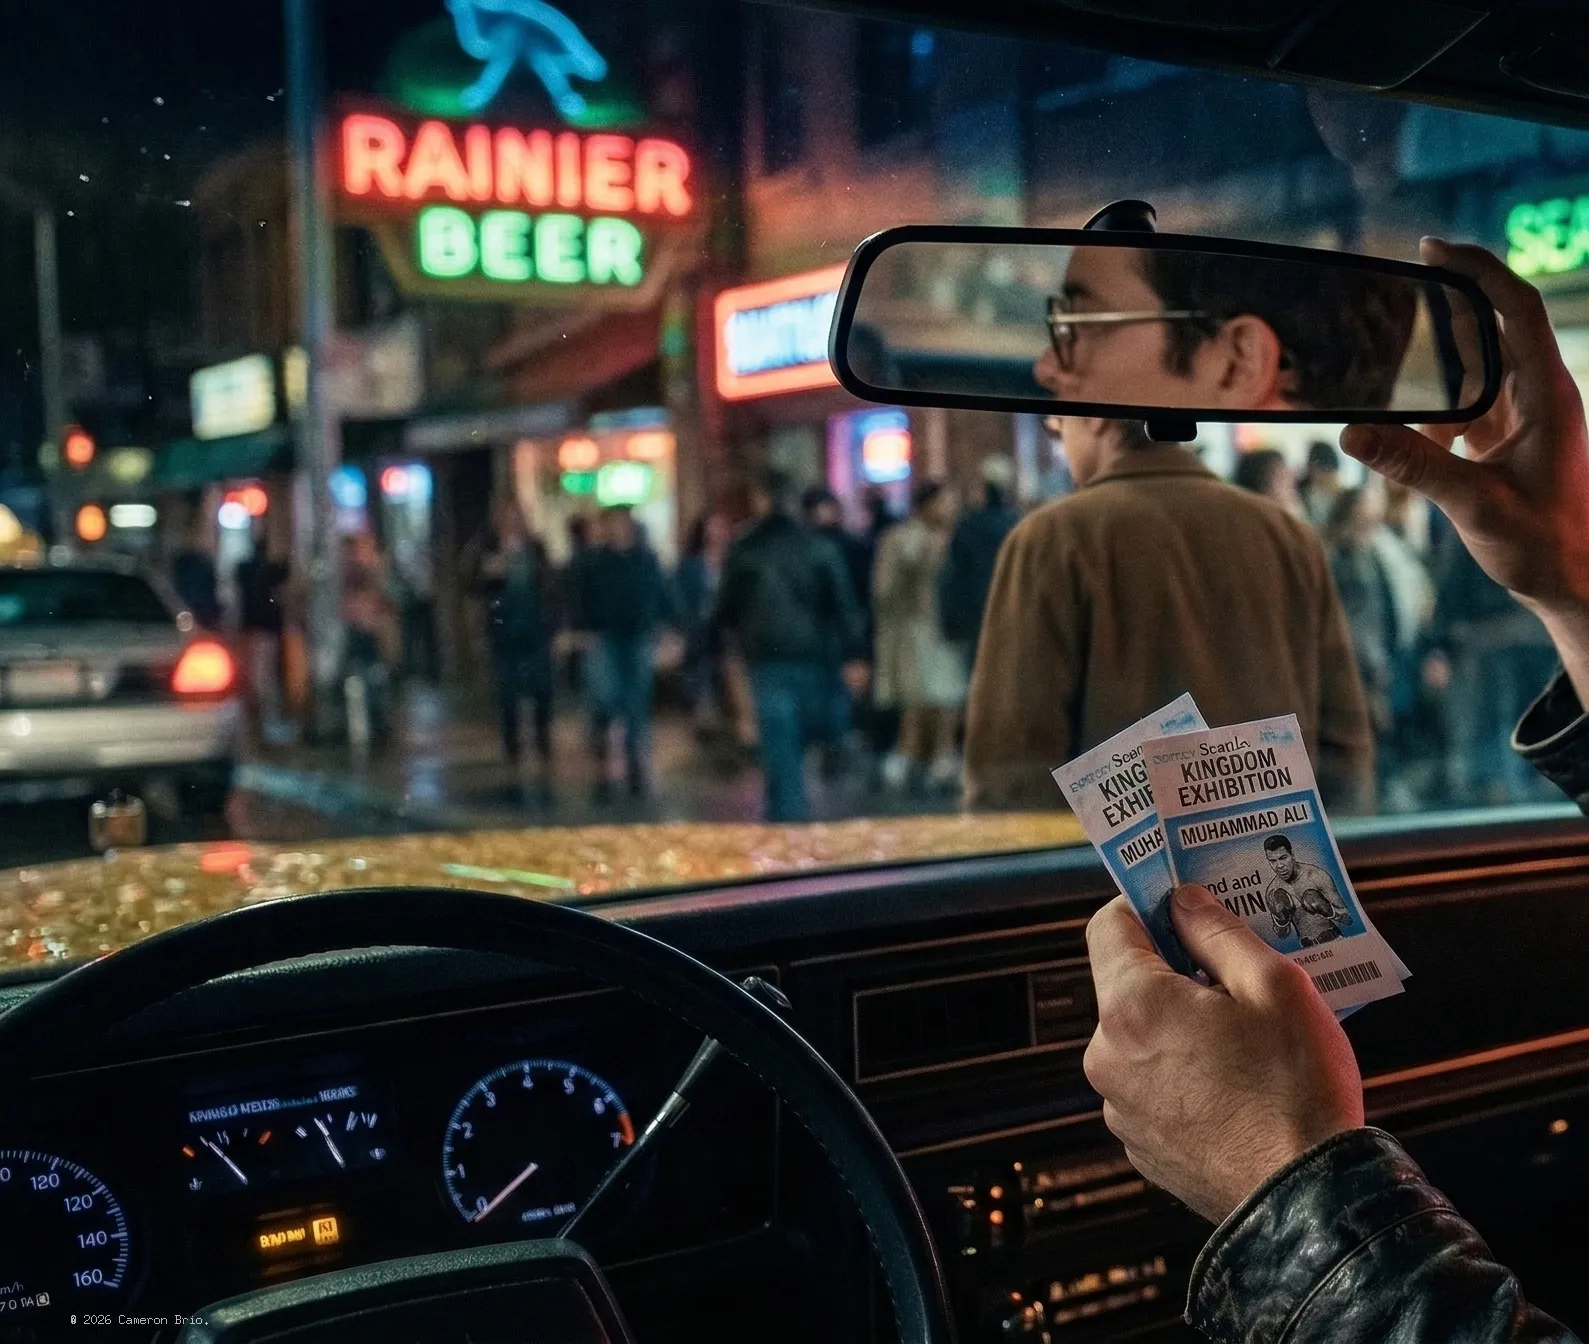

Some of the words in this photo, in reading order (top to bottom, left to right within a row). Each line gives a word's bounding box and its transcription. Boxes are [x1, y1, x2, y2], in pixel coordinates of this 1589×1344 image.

[342, 113, 692, 217] RAINIER
[418, 206, 643, 286] BEER
[1098, 760, 1148, 802] KING
[1180, 747, 1277, 783] KINGDOM
[1178, 767, 1292, 807] EXHIBITION
[1181, 811, 1278, 845] MUHAMMAD
[1284, 804, 1308, 823] ALI
[1120, 827, 1164, 865] MUHA
[1232, 870, 1262, 891] and
[462, 1122, 474, 1139] 2
[30, 1173, 60, 1190] 120
[63, 1194, 93, 1212] 120
[77, 1230, 107, 1248] 140
[73, 1268, 103, 1287] 160
